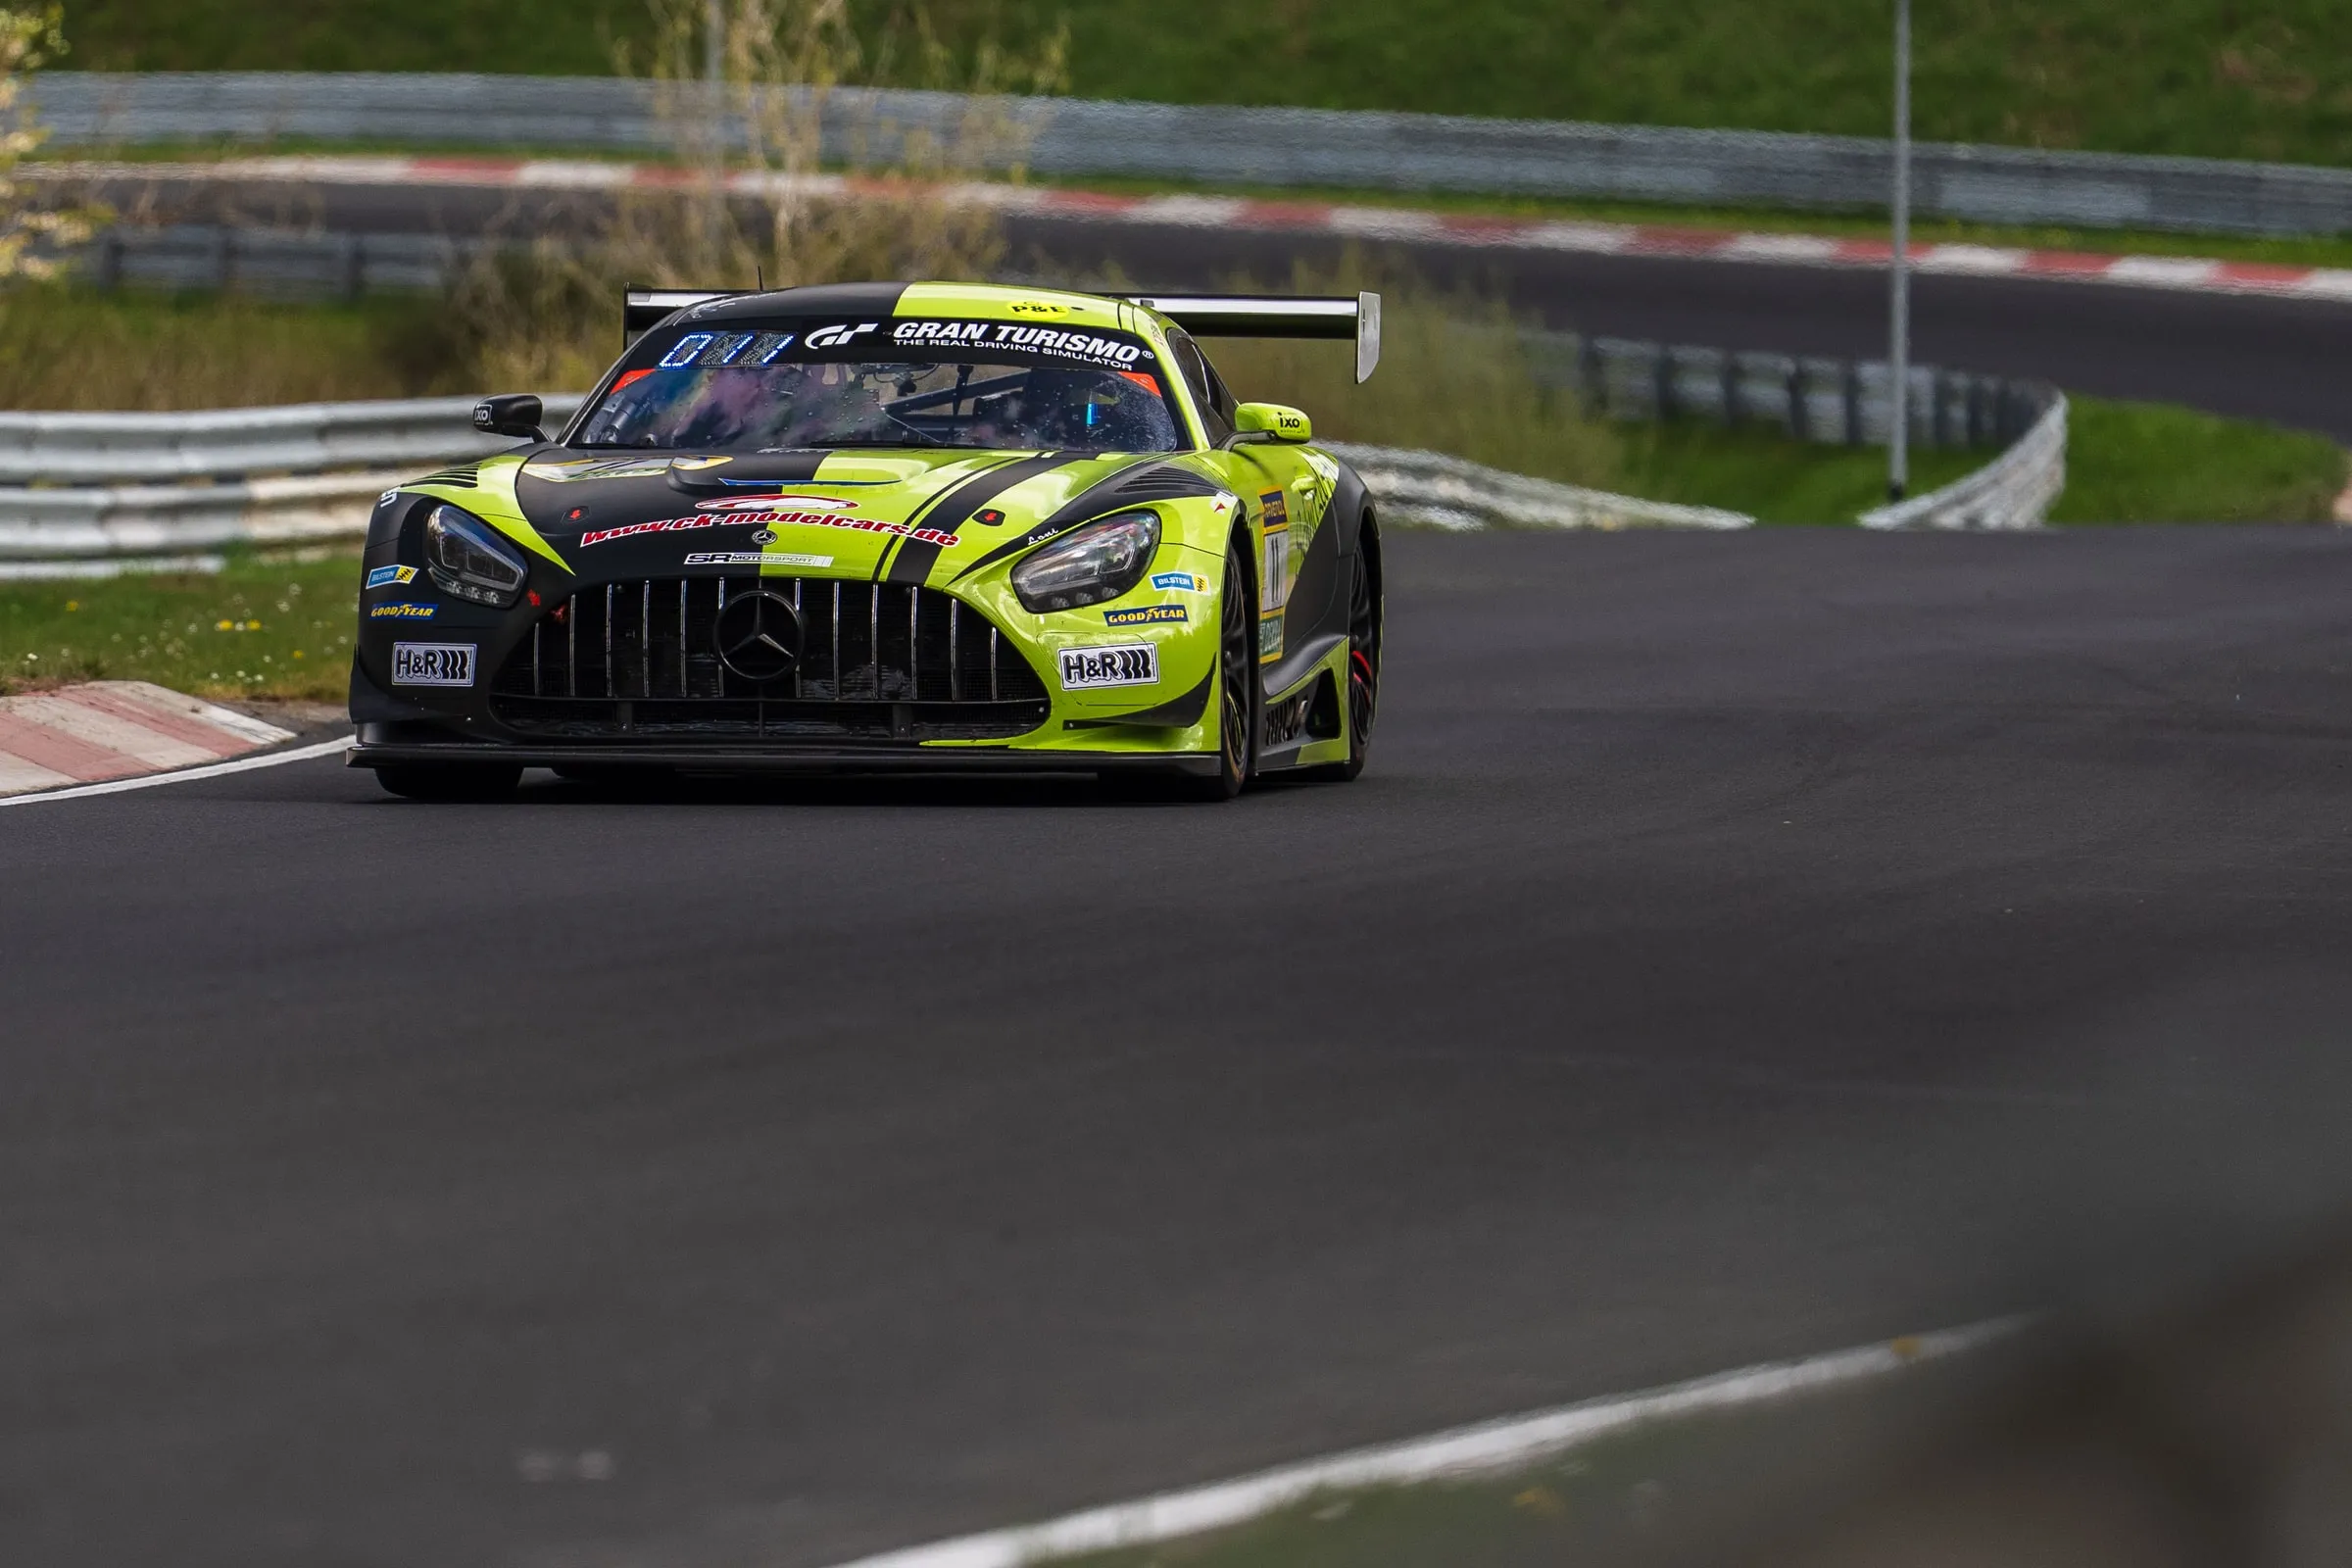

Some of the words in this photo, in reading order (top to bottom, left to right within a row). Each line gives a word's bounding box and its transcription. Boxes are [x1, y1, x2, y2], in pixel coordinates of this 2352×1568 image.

[893, 321, 990, 340] GRAN
[974, 341, 1038, 354] DRIVING
[1042, 348, 1133, 371] SIMULATOR
[1157, 576, 1191, 585] BILSTEIN
[1108, 608, 1185, 623] GOODYEAR
[396, 649, 443, 681] H&R
[1063, 650, 1123, 684] H&R
